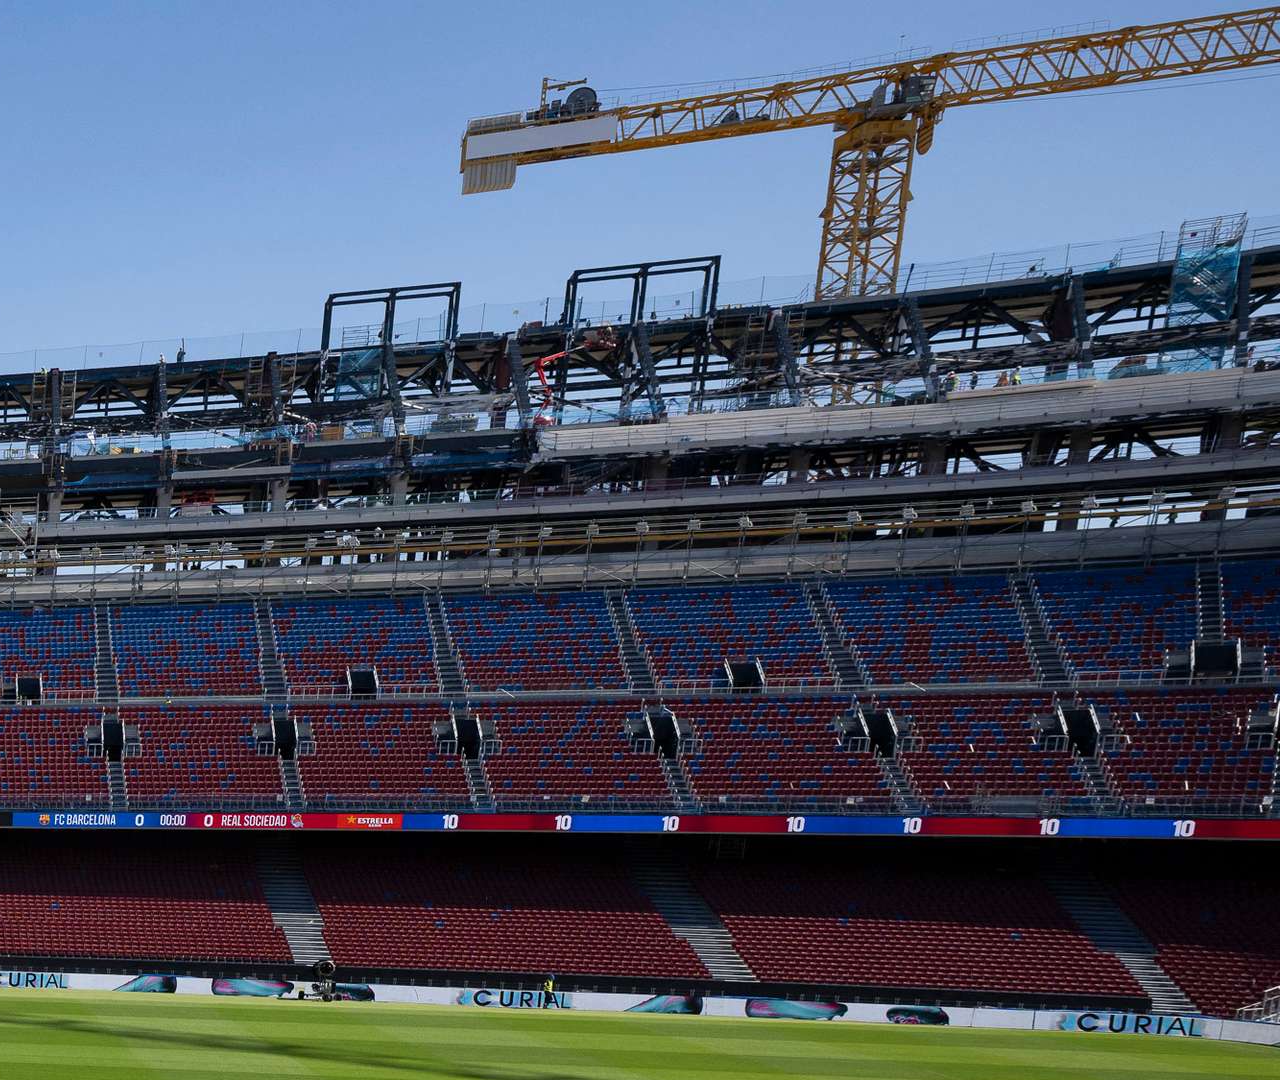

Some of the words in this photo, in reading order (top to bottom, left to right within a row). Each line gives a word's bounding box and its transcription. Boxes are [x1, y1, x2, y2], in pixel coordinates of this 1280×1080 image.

[54, 813, 65, 826] FC
[66, 814, 117, 826] BARCELONA
[135, 814, 145, 827] 0
[160, 814, 187, 826] 00:00
[203, 814, 214, 827] 0
[221, 814, 242, 827] REAL
[243, 814, 287, 827] SOCIEDAD
[357, 817, 393, 825] ESTRELLA
[442, 814, 459, 829] 10
[555, 815, 572, 830] 10
[662, 815, 680, 831] 10
[786, 816, 805, 832] 10
[903, 817, 922, 834] 10
[1039, 818, 1060, 835] 10
[1174, 820, 1196, 837] 10
[473, 990, 571, 1009] CURIAL
[1077, 1013, 1203, 1037] CURIAL
